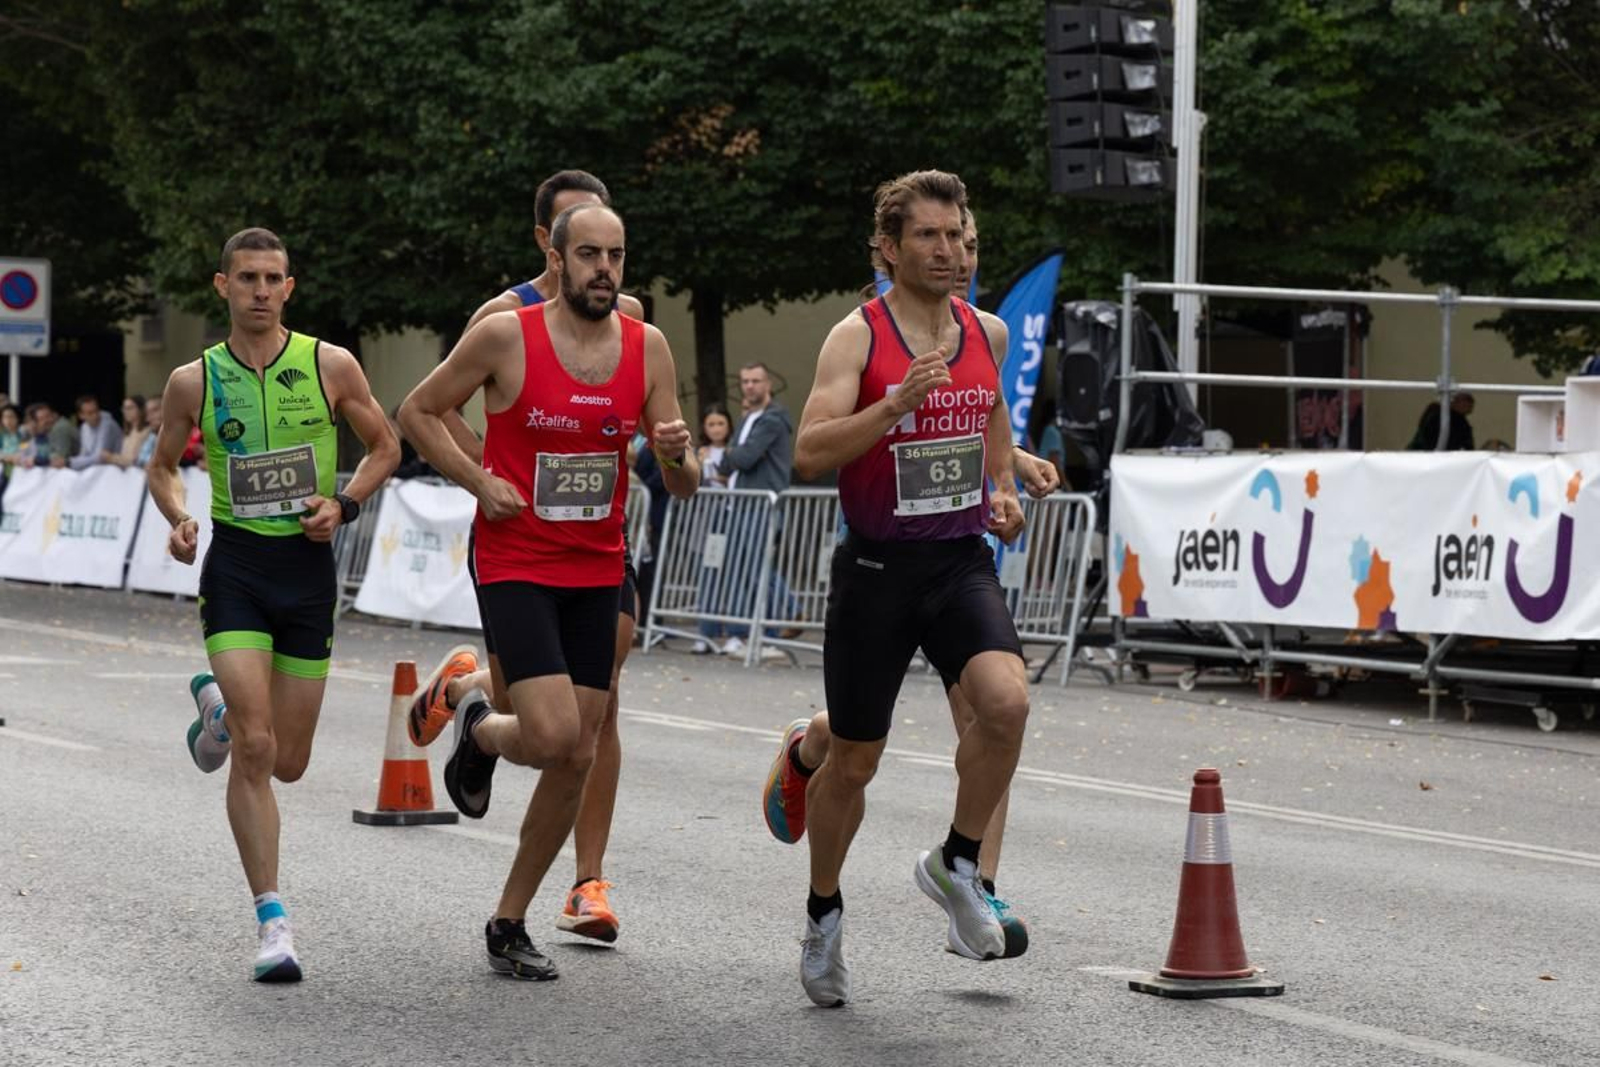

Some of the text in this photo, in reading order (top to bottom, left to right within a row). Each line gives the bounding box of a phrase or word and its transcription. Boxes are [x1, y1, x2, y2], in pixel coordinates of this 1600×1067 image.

[1011, 312, 1046, 445] orus
[279, 394, 310, 408] Unicaja
[921, 407, 990, 435] ndúja
[905, 448, 920, 459] 36
[544, 458, 560, 469] 36
[930, 459, 962, 483] 63
[247, 467, 297, 492] 120
[555, 472, 604, 493] 259
[236, 491, 286, 503] FRANCISCO
[919, 486, 943, 497] JOSÉ
